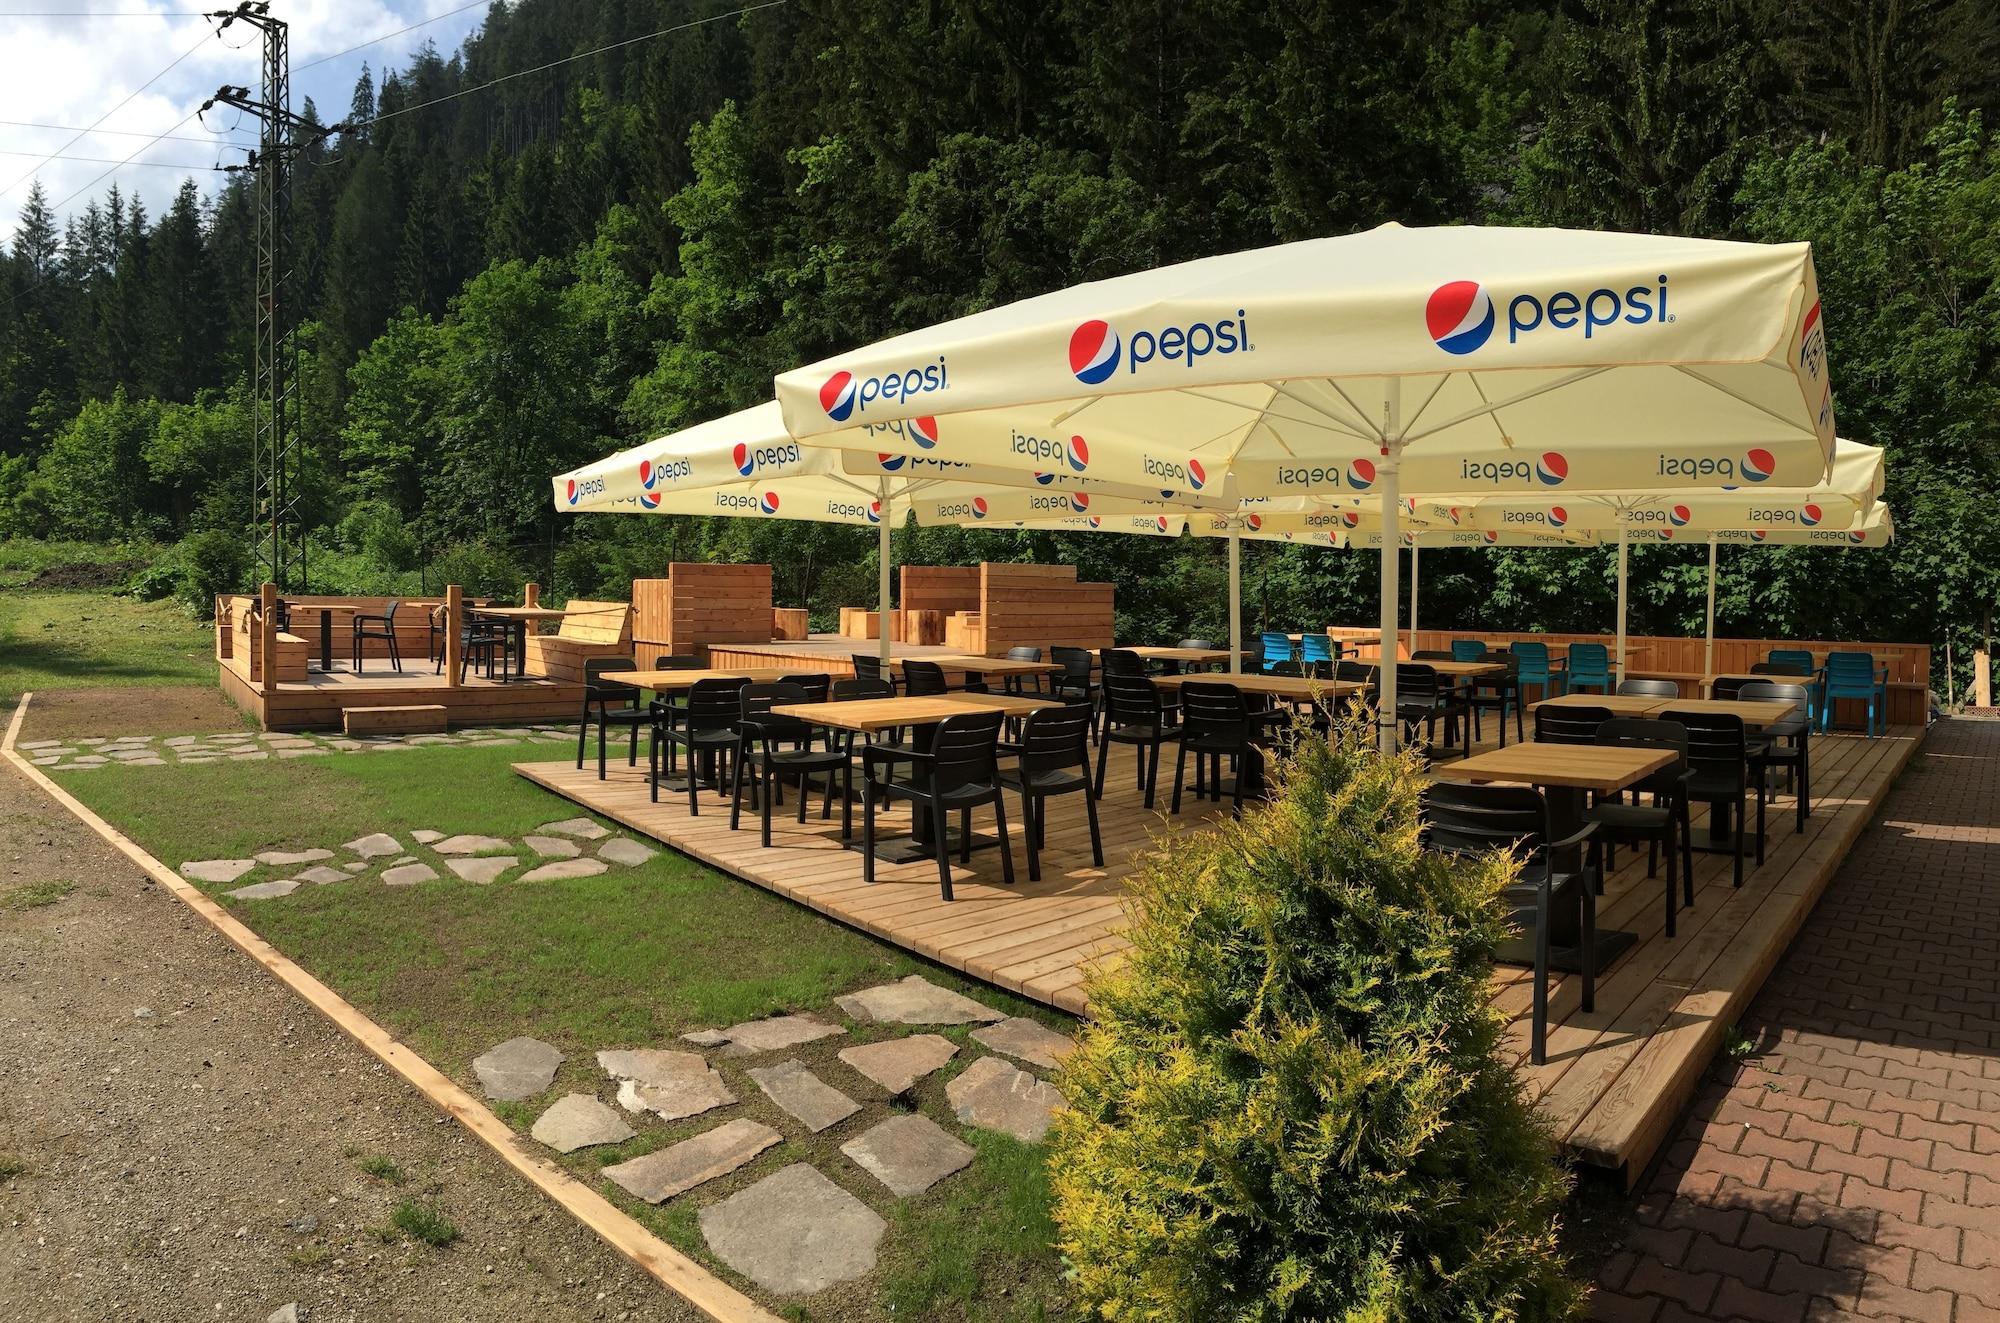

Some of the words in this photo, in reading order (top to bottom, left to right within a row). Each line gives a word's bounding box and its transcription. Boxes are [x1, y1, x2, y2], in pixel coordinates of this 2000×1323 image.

[1509, 274, 1668, 344] pepsi
[1130, 309, 1248, 374] pepsi
[860, 355, 946, 411] pepsi
[657, 456, 691, 485] pepsi
[756, 440, 800, 471] pepsi
[580, 474, 606, 500] pepsi
